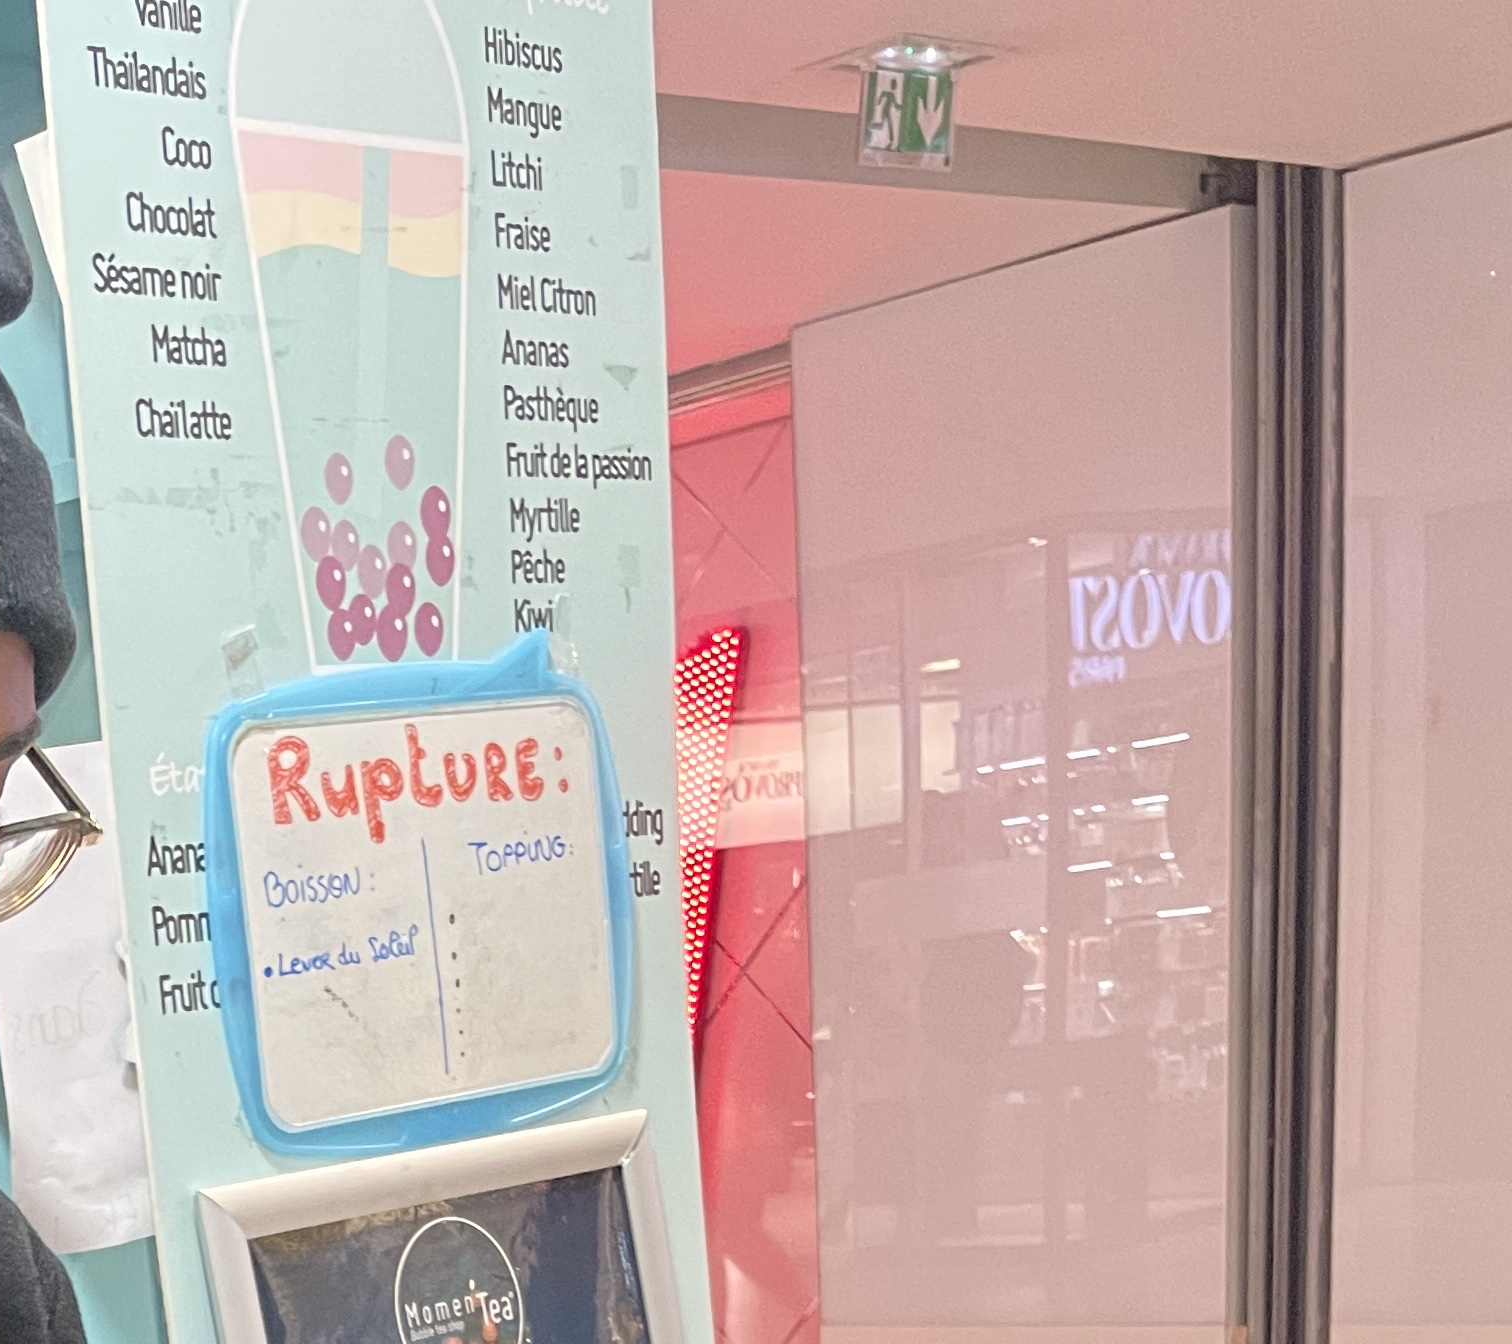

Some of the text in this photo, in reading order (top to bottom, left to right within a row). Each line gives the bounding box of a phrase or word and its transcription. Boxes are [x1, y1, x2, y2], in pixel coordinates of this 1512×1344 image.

[484, 26, 563, 73] Hibiscus
[487, 85, 562, 138] Mangue
[161, 126, 212, 170] Coco
[491, 149, 543, 191] Litchi
[126, 191, 217, 239] Chocolat
[494, 212, 551, 252] Fraise
[92, 252, 222, 301] Sésame noir
[497, 272, 597, 317] Miel Citron
[151, 323, 227, 367] Matcha
[501, 328, 570, 368] Ananas
[503, 384, 599, 433] Pasthèque
[506, 442, 653, 489] Fruit de la passion
[509, 497, 581, 542] Myrtille
[511, 548, 566, 584] Pêche
[514, 598, 554, 633] Kiwi
[149, 752, 205, 796] Éta
[147, 835, 206, 876] Anana
[629, 861, 661, 897] tille
[159, 969, 209, 1015] Fruit
